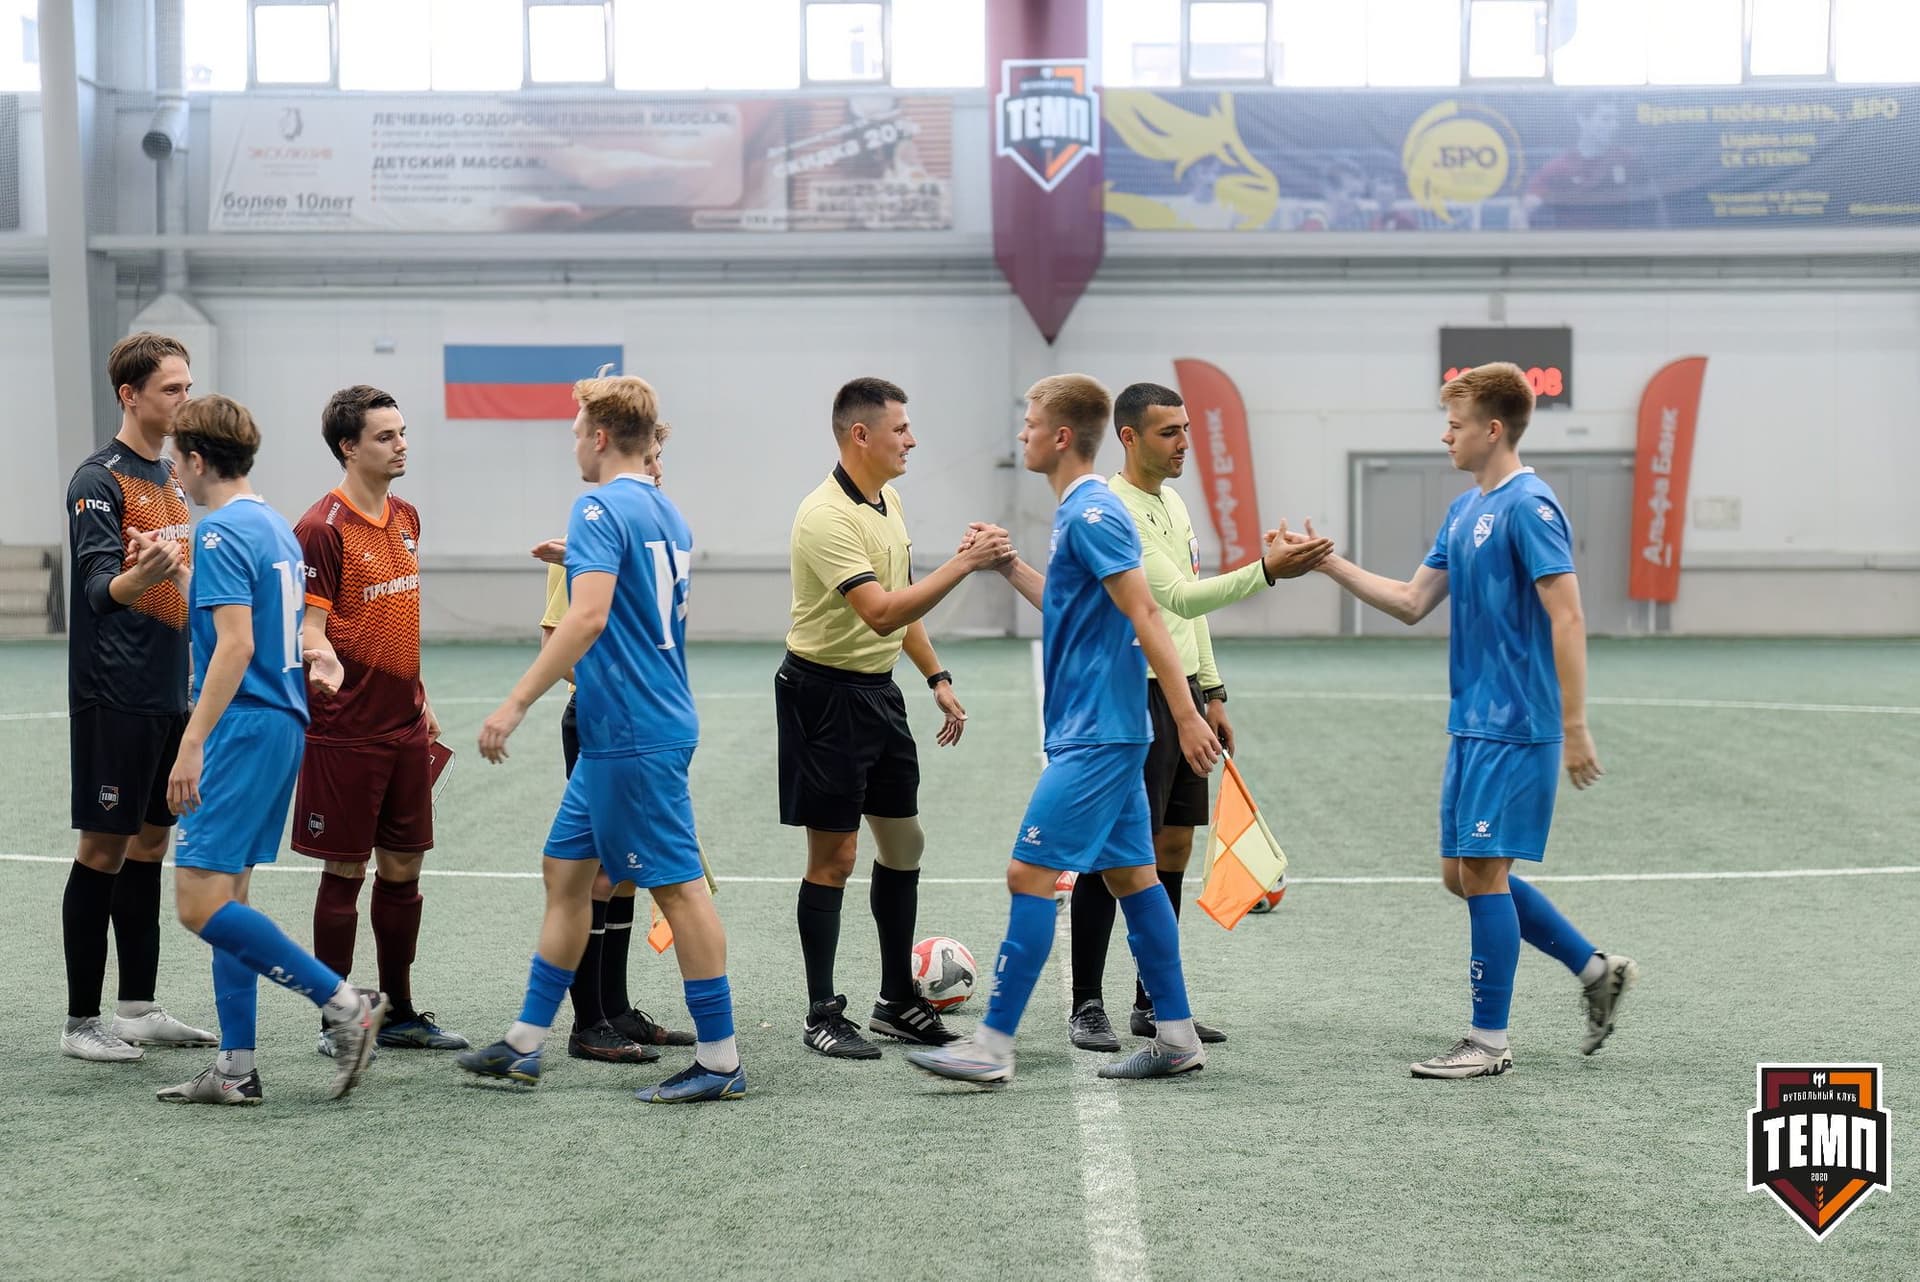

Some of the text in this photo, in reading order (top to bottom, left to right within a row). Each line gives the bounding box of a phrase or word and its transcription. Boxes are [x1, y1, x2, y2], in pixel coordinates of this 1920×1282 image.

[1006, 95, 1090, 141] ТЕМП
[372, 154, 457, 170] ДЕТСКИЙ
[223, 191, 288, 210] более
[86, 499, 111, 513] ПСБ
